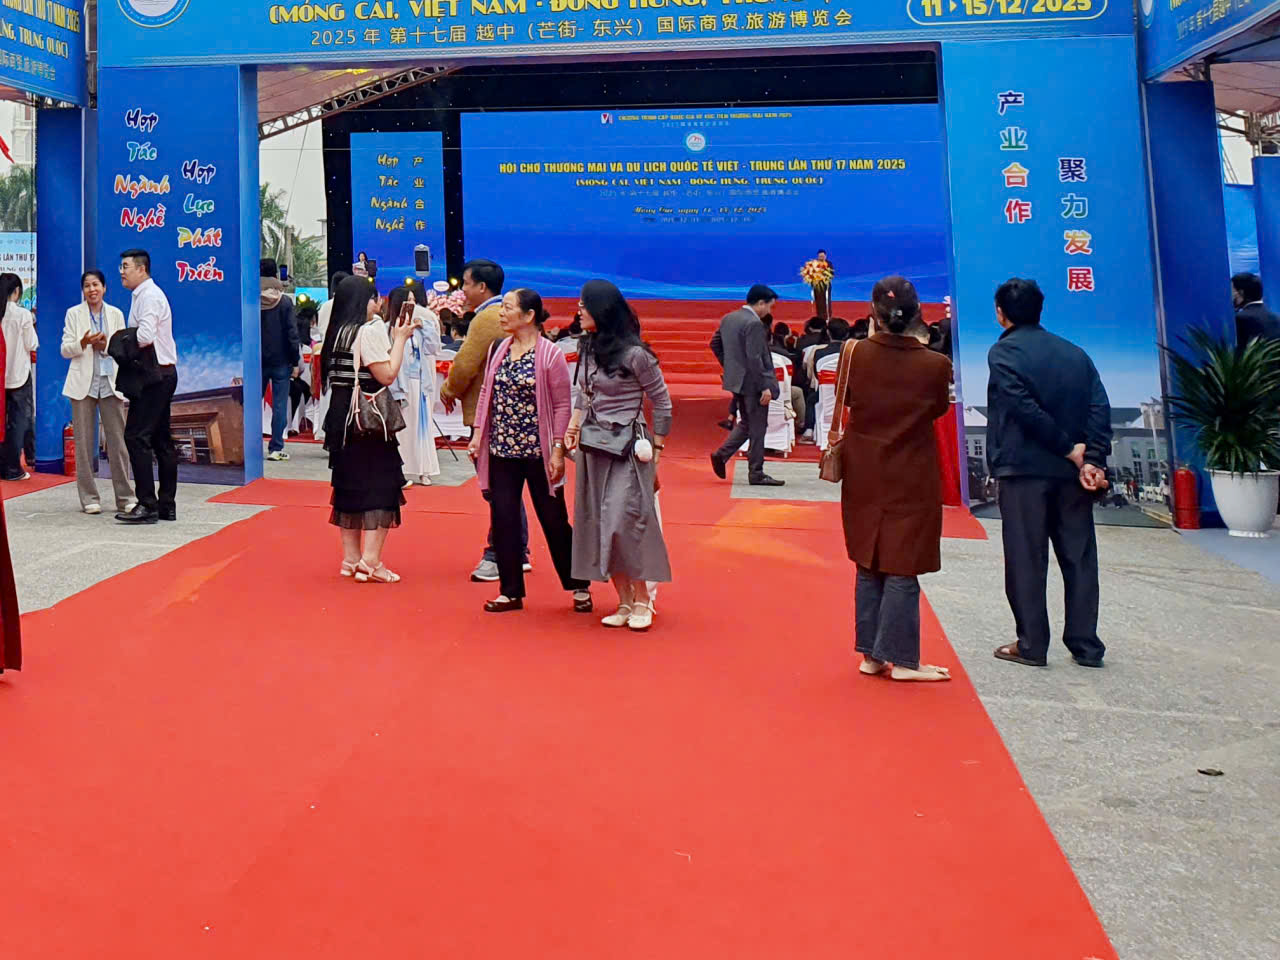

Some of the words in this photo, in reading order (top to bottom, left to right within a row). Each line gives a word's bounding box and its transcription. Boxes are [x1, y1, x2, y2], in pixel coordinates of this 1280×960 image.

[311, 28, 356, 47] 2025
[363, 27, 381, 45] 年
[125, 109, 159, 132] Hợp
[127, 141, 157, 162] Tác
[997, 91, 1032, 224] 产业合作
[182, 160, 216, 184] Hợp
[626, 162, 641, 172] DU
[749, 160, 785, 171] TRUNG
[835, 159, 846, 170] 17
[877, 158, 906, 170] 2025
[114, 174, 170, 199] Ngành
[184, 193, 214, 216] Lực
[121, 203, 165, 232] Nghề
[1058, 157, 1095, 291] 聚力发展
[177, 227, 222, 250] Phát
[176, 257, 224, 282] Triển
